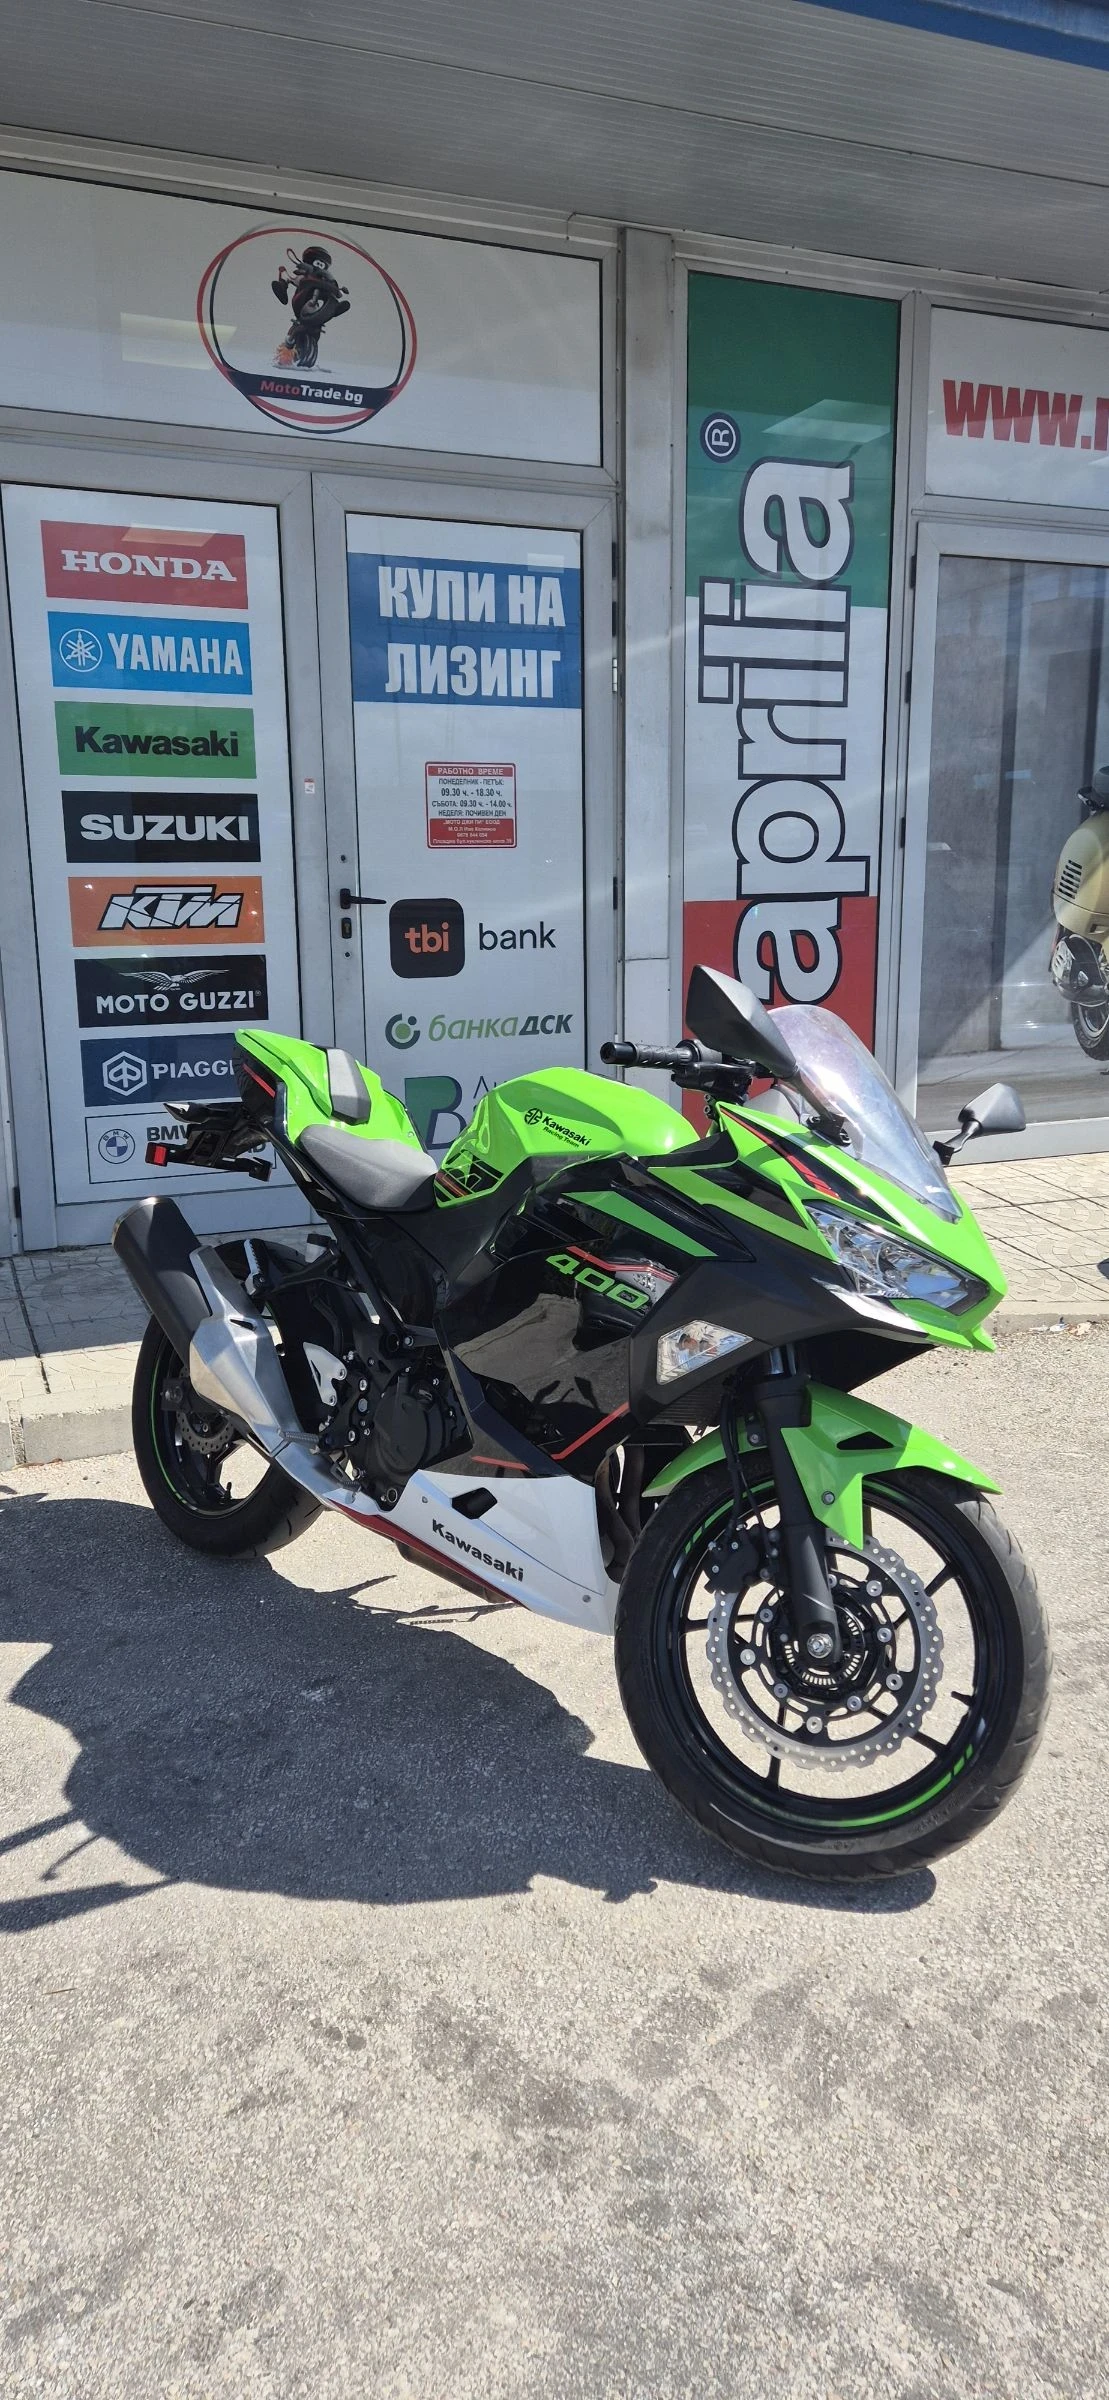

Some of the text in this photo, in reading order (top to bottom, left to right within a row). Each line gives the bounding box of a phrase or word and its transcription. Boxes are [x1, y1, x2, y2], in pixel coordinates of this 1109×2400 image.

[260, 380, 363, 405] MotoTrade.bg
[60, 549, 238, 582] HONDA
[378, 565, 566, 627] КУПИ НА
[107, 632, 244, 676] YAMAHA
[384, 642, 561, 698] ЛИЗИНГ
[74, 725, 239, 757] Kawasaki
[698, 455, 870, 1005] aprilia
[437, 767, 504, 776] РАБОТНО ВРЕМЕ
[431, 800, 458, 808] СЪБОТА:
[459, 800, 477, 808] 09.30
[490, 800, 507, 808] 14.00
[441, 788, 460, 797] 09.30
[476, 788, 495, 797] 18.30
[80, 813, 250, 841] SUZUKI
[97, 884, 244, 931] KTM
[404, 921, 557, 954] tbi bank
[96, 990, 255, 1014] MOTO GUZZI
[151, 1059, 235, 1080] PIAGGI
[542, 1116, 592, 1146] Kawasaki
[545, 1254, 650, 1310] 400
[432, 1518, 524, 1582] Kawasaki
